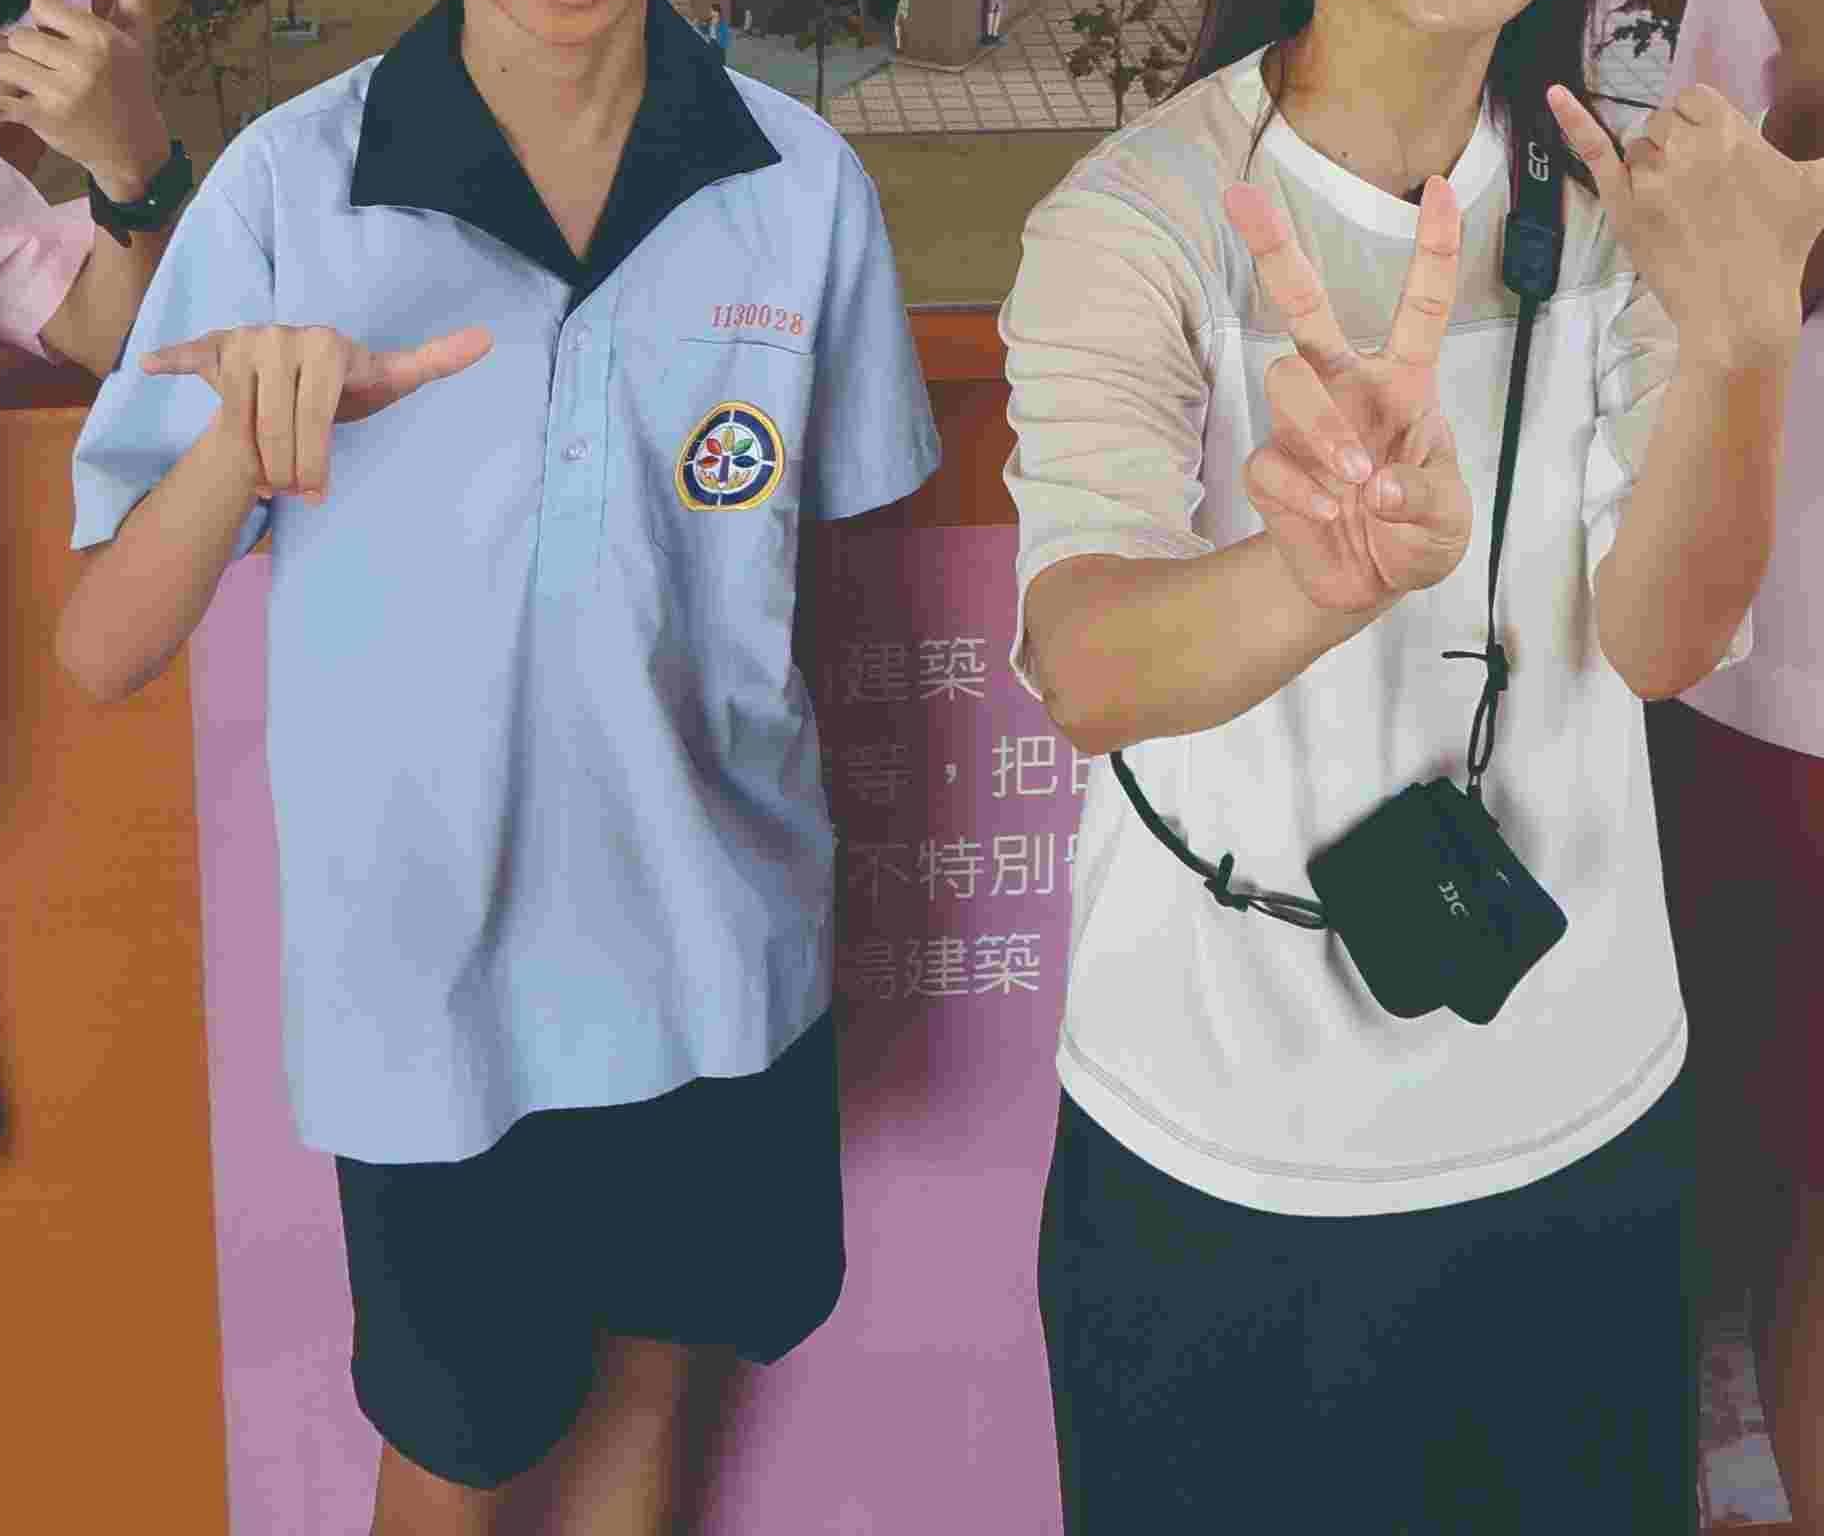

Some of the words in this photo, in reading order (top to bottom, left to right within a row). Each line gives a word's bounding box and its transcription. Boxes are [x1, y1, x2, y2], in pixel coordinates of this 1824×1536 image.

[824, 636, 986, 705] 建築
[844, 831, 1080, 904] 不特別
